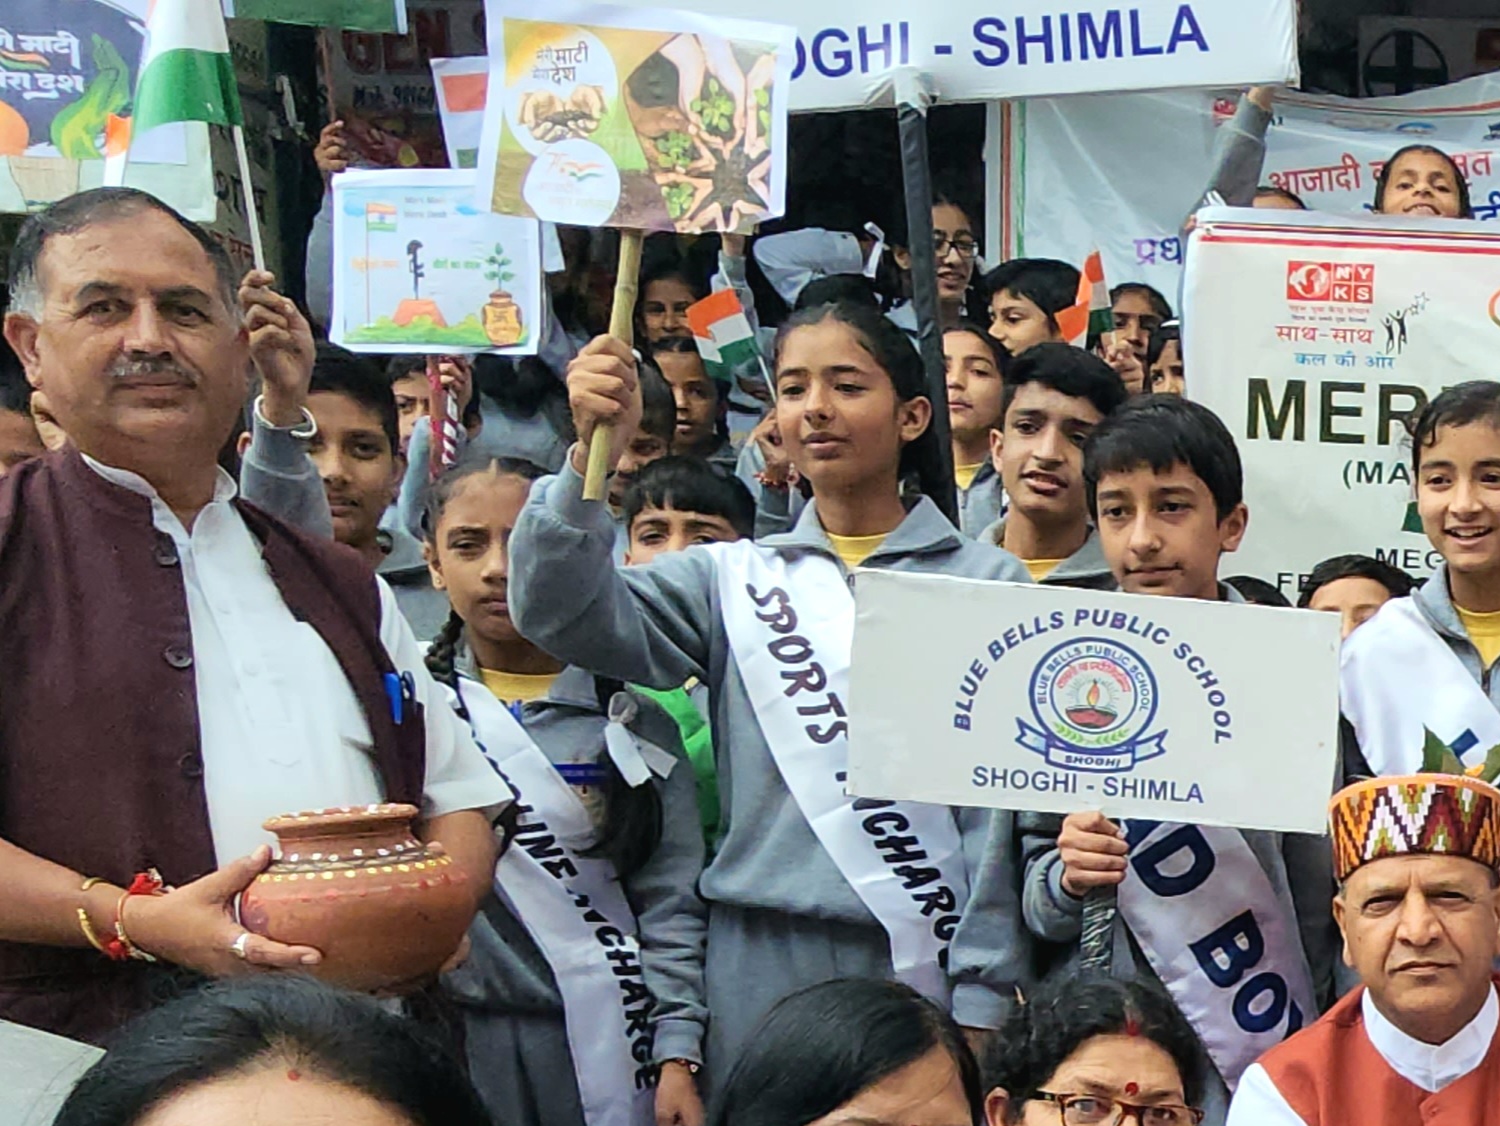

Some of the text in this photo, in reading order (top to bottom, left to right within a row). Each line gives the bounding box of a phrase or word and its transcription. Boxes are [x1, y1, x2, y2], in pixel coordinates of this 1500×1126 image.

[17, 30, 82, 70] माटी
[555, 41, 588, 64] माटी
[972, 3, 1210, 68] SHIMLA
[551, 61, 576, 85] देश
[1268, 153, 1361, 194] आजादी
[1133, 237, 1183, 265] प्रध
[1275, 325, 1374, 344] साथ-साथ
[1294, 350, 1396, 369] कल की ओर
[1246, 378, 1430, 446] MER
[1342, 460, 1411, 489] (MA
[1375, 547, 1443, 570] MEG
[746, 582, 848, 745] SPORTS
[953, 658, 989, 731] BLUE
[987, 611, 1064, 662] BELLS
[1074, 609, 1170, 645] PUBLIC
[1173, 642, 1232, 743] SCHOOL
[1037, 674, 1050, 705] BLUE
[1046, 646, 1082, 672] BELLS
[1086, 645, 1130, 666] PUBLIC
[1130, 665, 1150, 712] SCHOOL
[972, 766, 1077, 793] SHOGHI
[1103, 776, 1204, 803] SHIMLA
